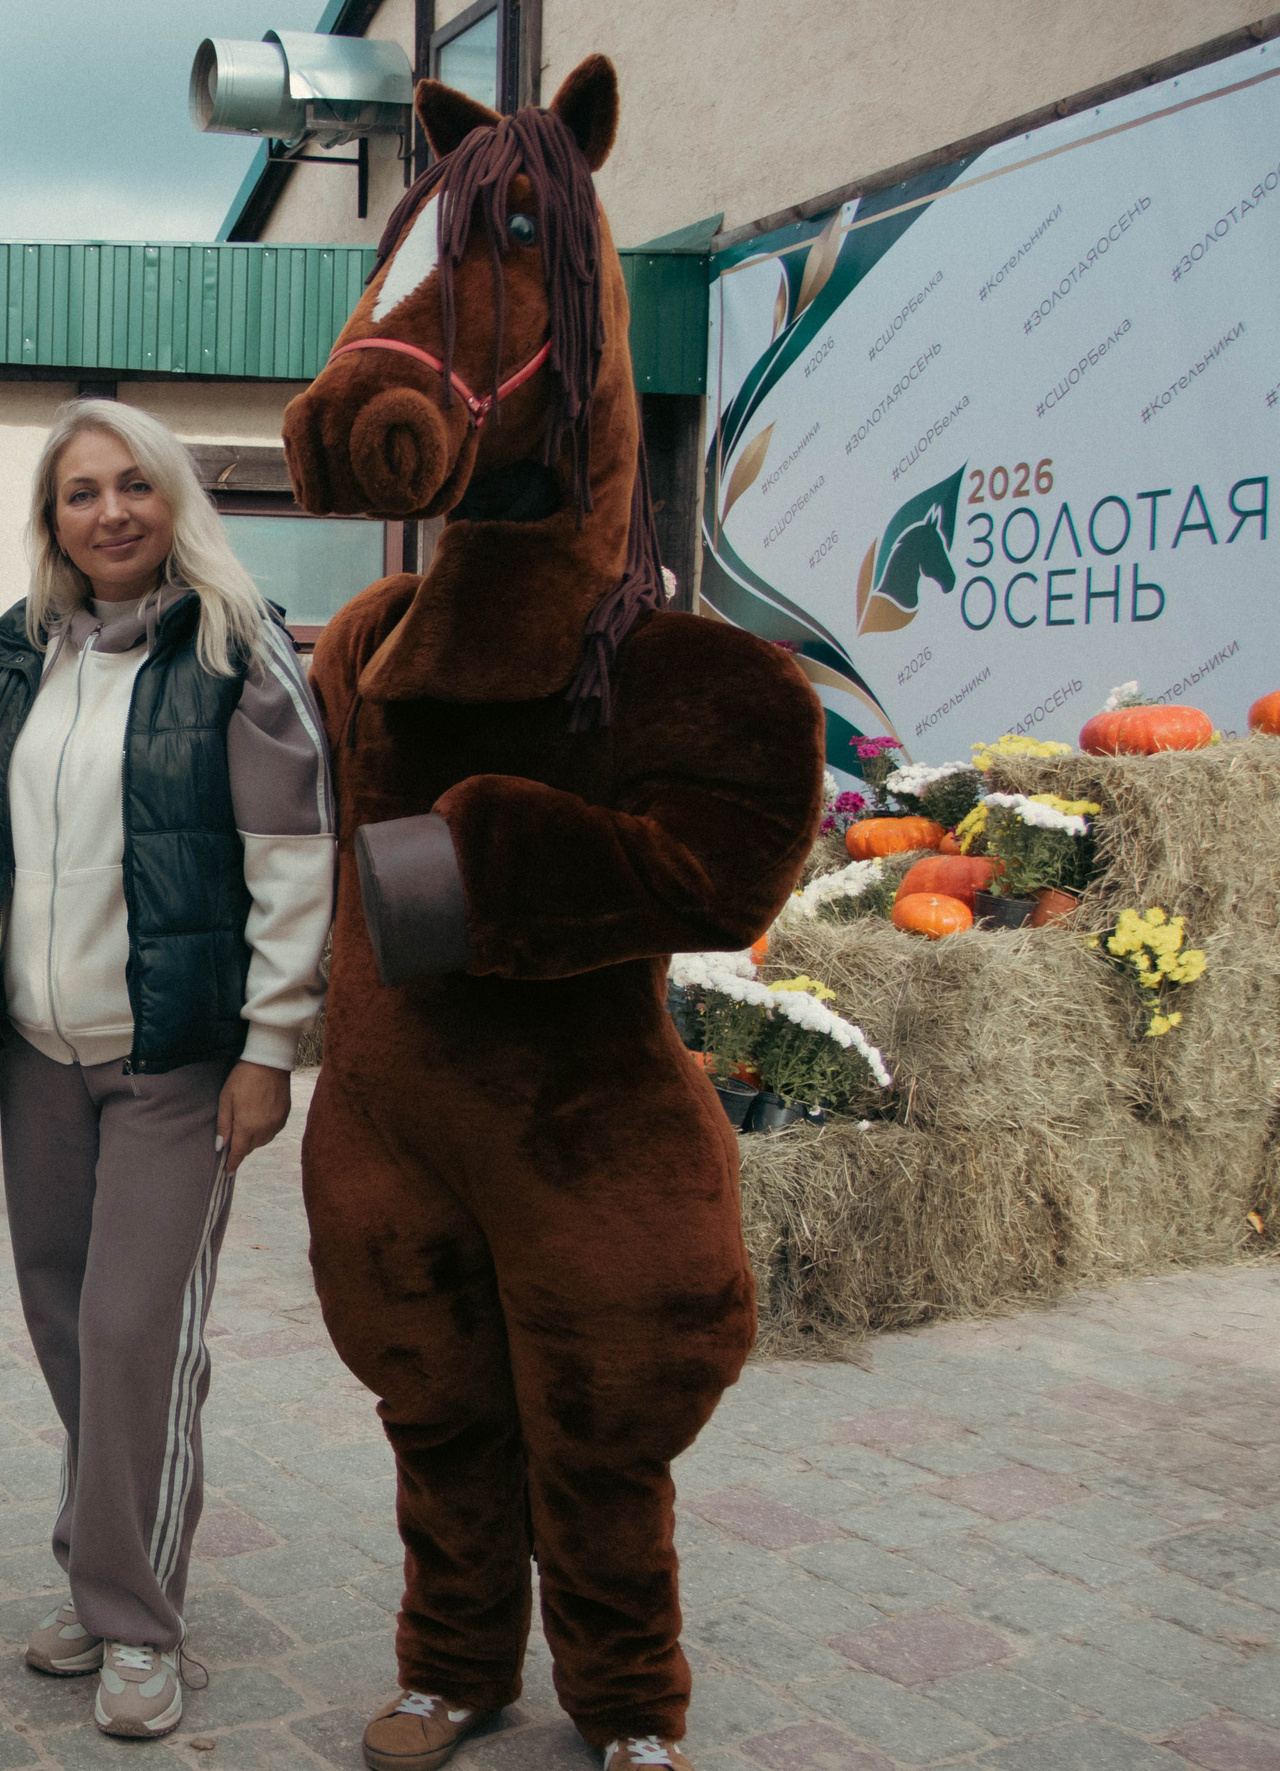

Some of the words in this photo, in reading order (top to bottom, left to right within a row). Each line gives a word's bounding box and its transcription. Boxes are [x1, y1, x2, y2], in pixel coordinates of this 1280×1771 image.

[978, 204, 1063, 302] #Котельники
[1171, 162, 1280, 283] #ЗОЛОТАЯО
[1023, 196, 1152, 335] #ЗОЛОТАЯОСЕНЬ
[868, 270, 944, 362] #СШОРБелка
[803, 336, 835, 379] #2026
[1035, 318, 1132, 419] #СШОРБелка
[1140, 321, 1246, 425] #Котельники
[844, 343, 942, 456] #ЗОЛОТАЯОСЕНЬ
[891, 395, 970, 482] #СШОРБелка
[761, 422, 821, 495] #Котельники
[968, 458, 1053, 504] 2026
[763, 475, 825, 549] #СШОРБелка
[809, 530, 839, 569] #2026
[966, 475, 1269, 568] ЗОЛОТАЯ
[960, 562, 1166, 631] ОСЕНЬ
[897, 646, 932, 686] #2026
[915, 667, 991, 737] #Котельники
[1001, 679, 1082, 736] ТАЯОСЕНЬ
